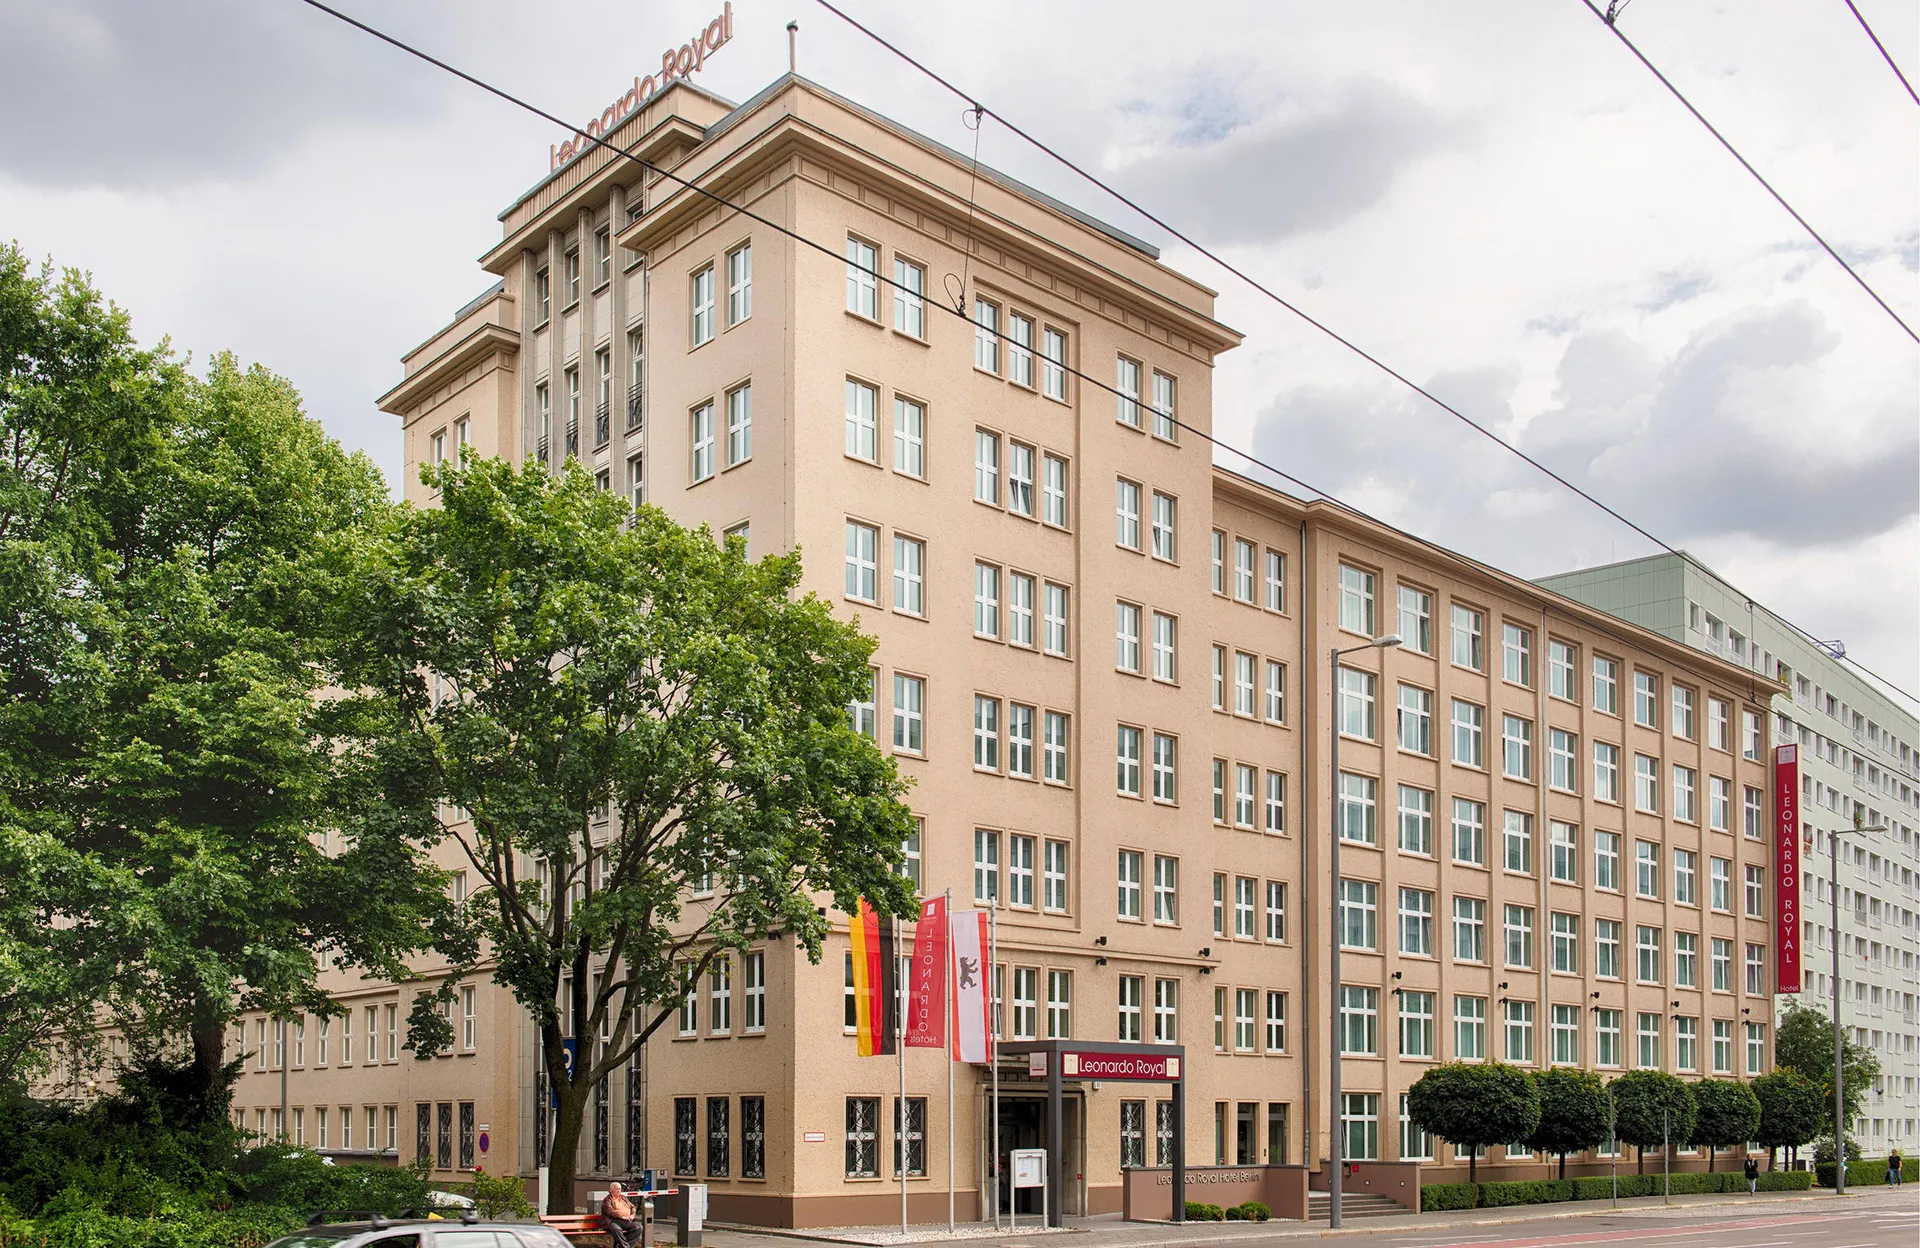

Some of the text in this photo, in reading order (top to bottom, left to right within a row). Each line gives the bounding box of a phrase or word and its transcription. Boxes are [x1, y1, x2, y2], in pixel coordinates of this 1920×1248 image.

[550, 1, 733, 172] Leonardo Royal
[1782, 784, 1794, 963] LEONARDO ROYAL
[1780, 984, 1799, 993] Hotel
[1079, 1057, 1166, 1077] Leonardo Royal
[1156, 1173, 1196, 1185] Leodo
[1197, 1172, 1218, 1185] Royal
[1219, 1171, 1239, 1182] Hotel
